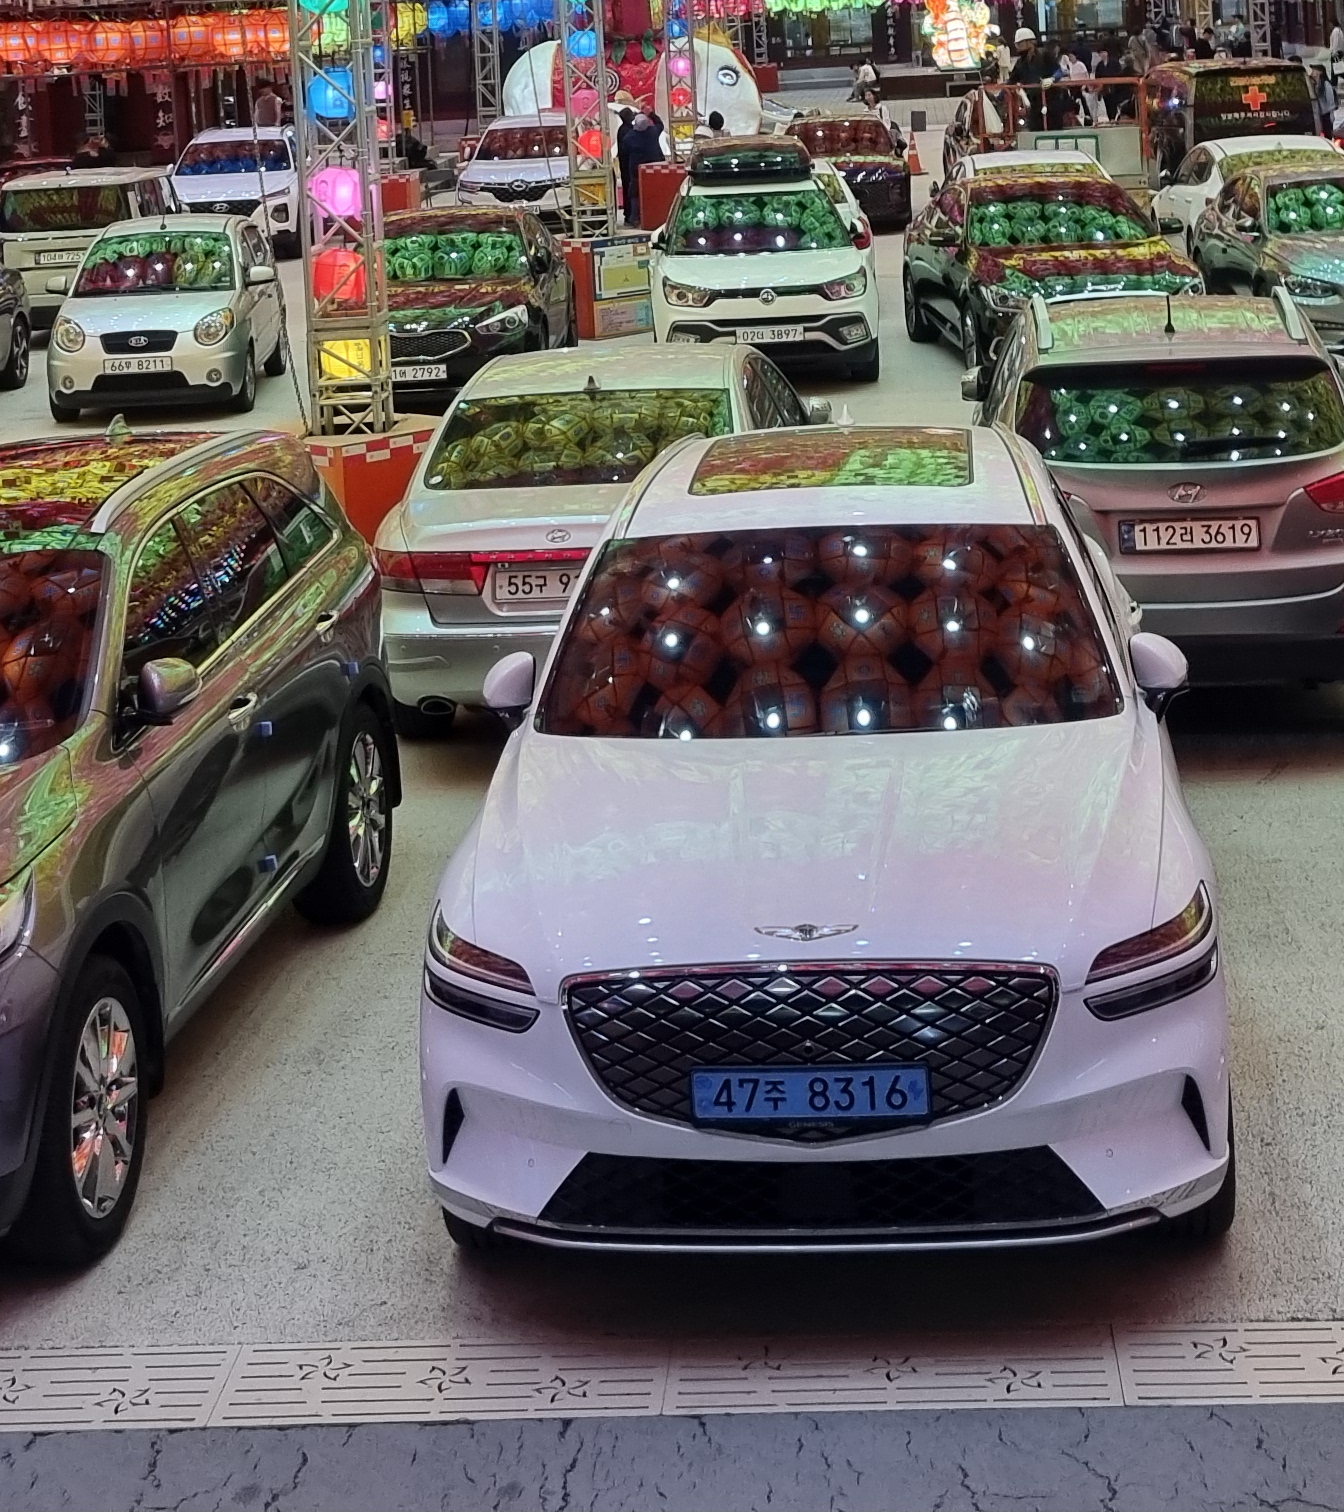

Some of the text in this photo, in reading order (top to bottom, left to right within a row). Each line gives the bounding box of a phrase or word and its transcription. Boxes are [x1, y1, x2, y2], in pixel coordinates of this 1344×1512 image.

[769, 328, 798, 341] 3897
[137, 359, 165, 371] 8211
[412, 366, 441, 379] 2792
[1201, 522, 1253, 545] 3619
[507, 574, 548, 596] 55구
[712, 1074, 909, 1114] 47주 8316
